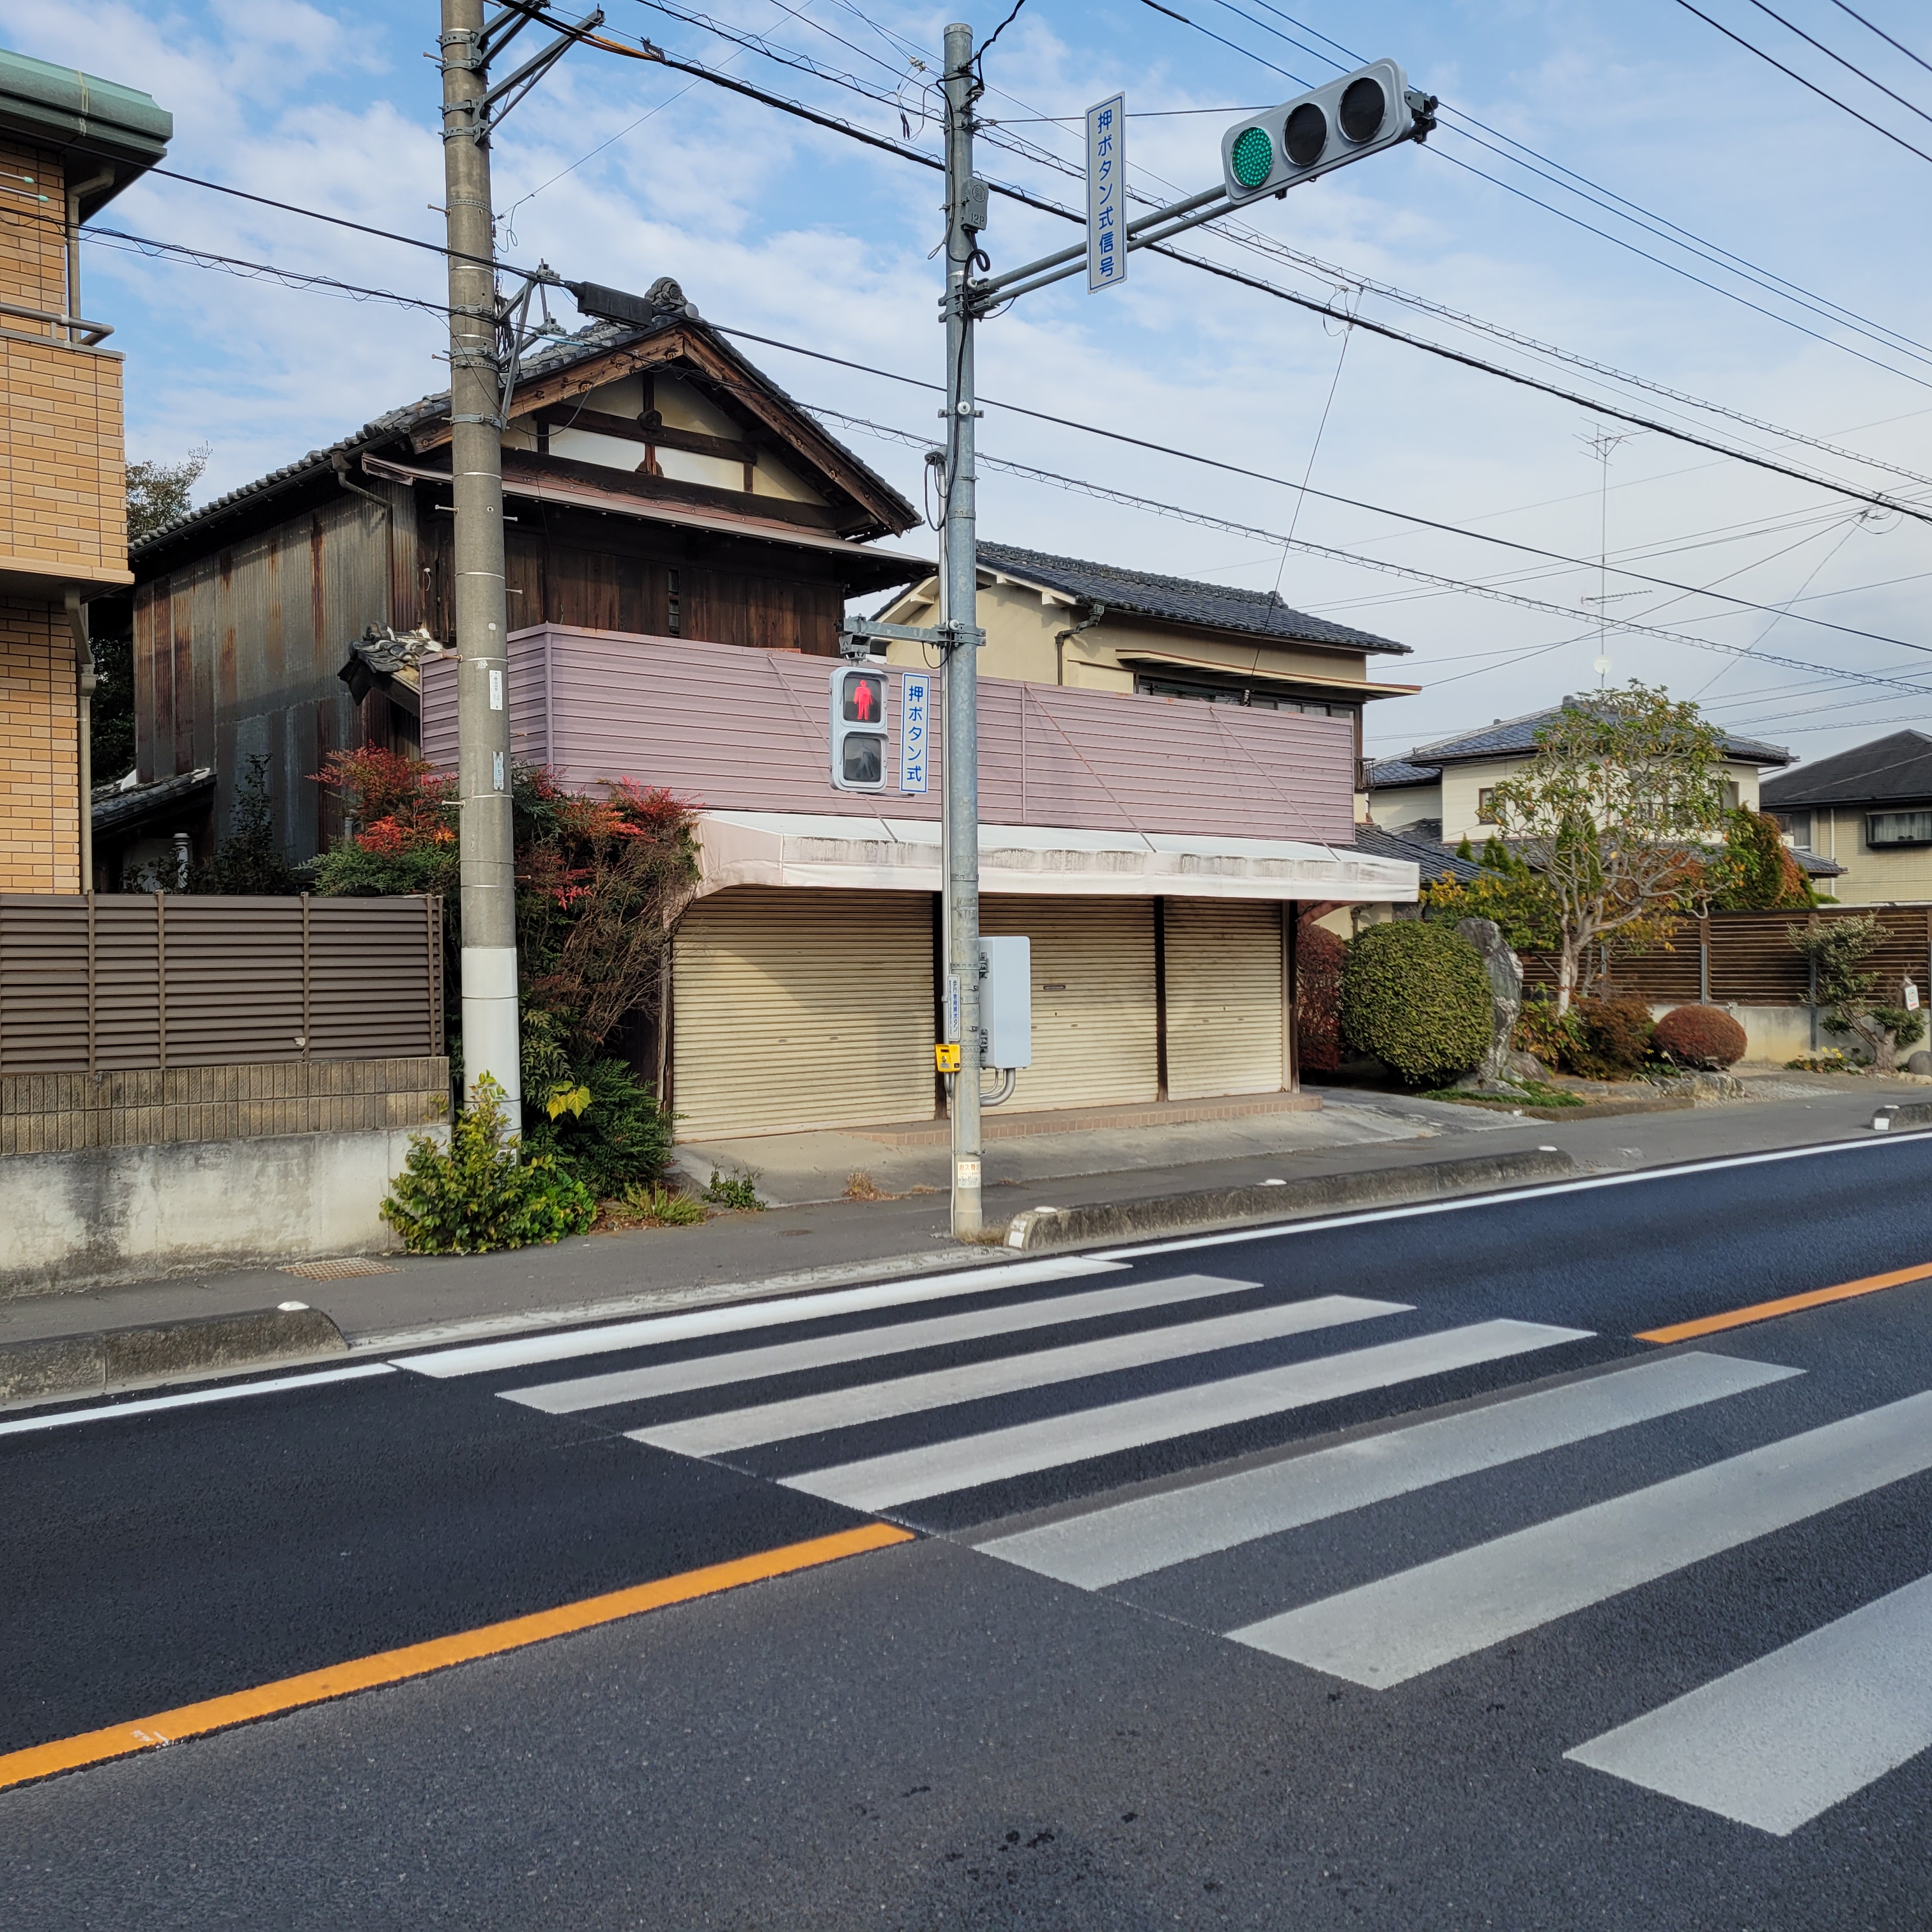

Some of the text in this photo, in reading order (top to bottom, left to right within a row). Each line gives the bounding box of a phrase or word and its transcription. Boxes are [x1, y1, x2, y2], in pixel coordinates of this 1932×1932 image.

[970, 212, 985, 225] 12P
[1097, 109, 1115, 277] 押ボタン式信号
[906, 685, 924, 782] 押ボタン式
